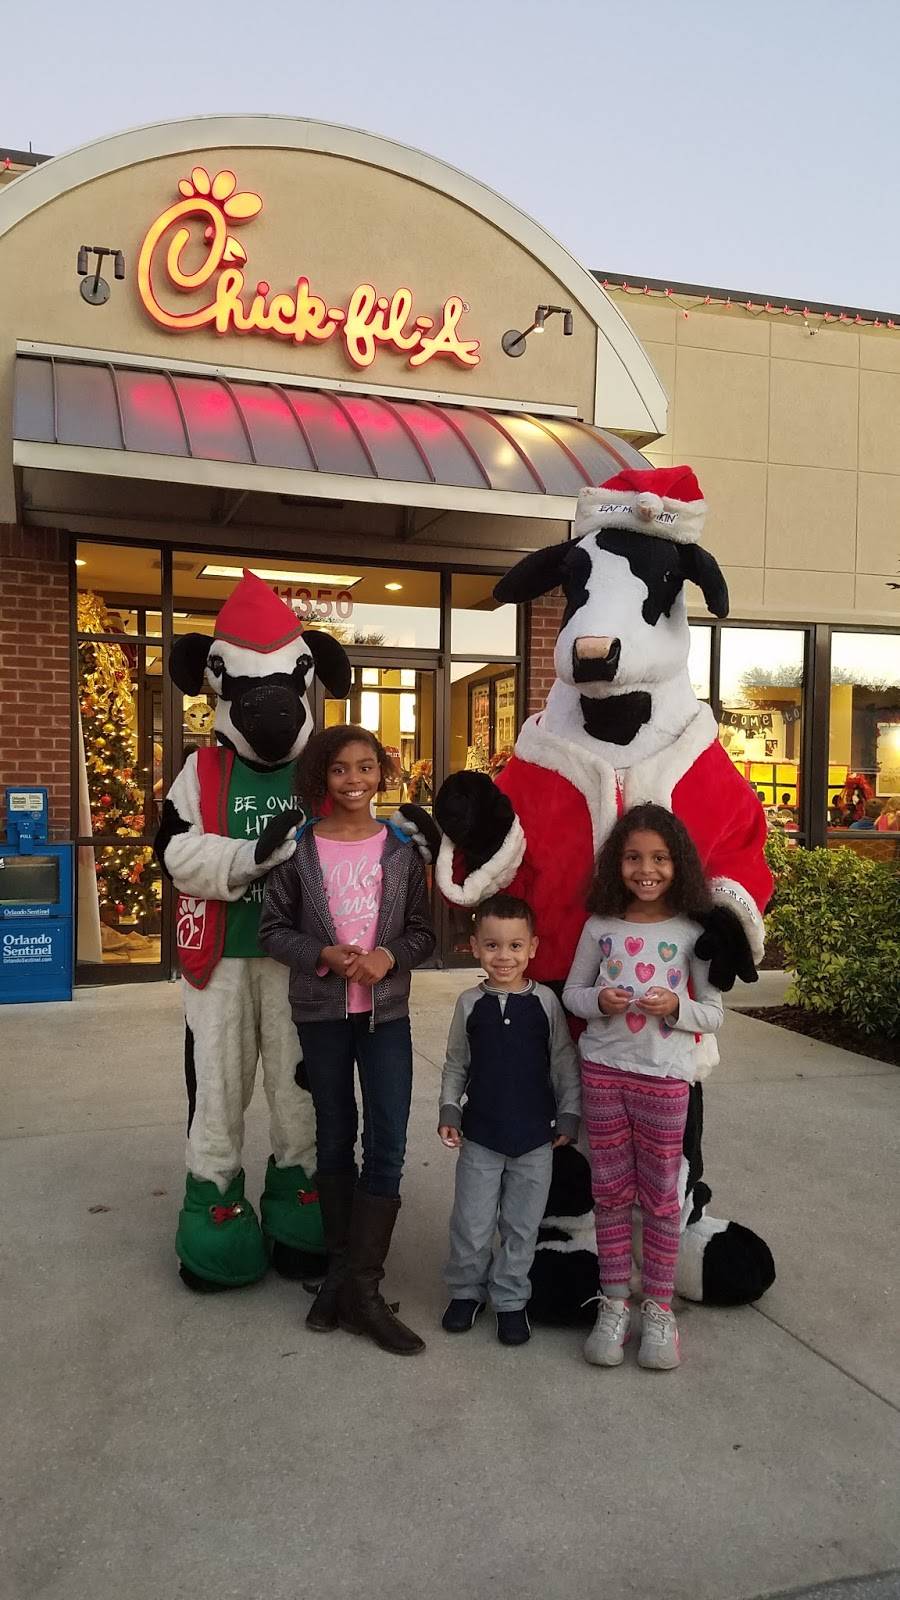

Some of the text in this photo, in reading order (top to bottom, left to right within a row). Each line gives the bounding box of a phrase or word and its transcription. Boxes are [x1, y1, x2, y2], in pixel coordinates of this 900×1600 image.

[137, 167, 481, 369] Chick-fil-A
[234, 795, 257, 813] BE
[3, 908, 50, 917] Orlando Sentinel
[3, 934, 52, 946] Orlando
[3, 944, 53, 957] Sentinel
